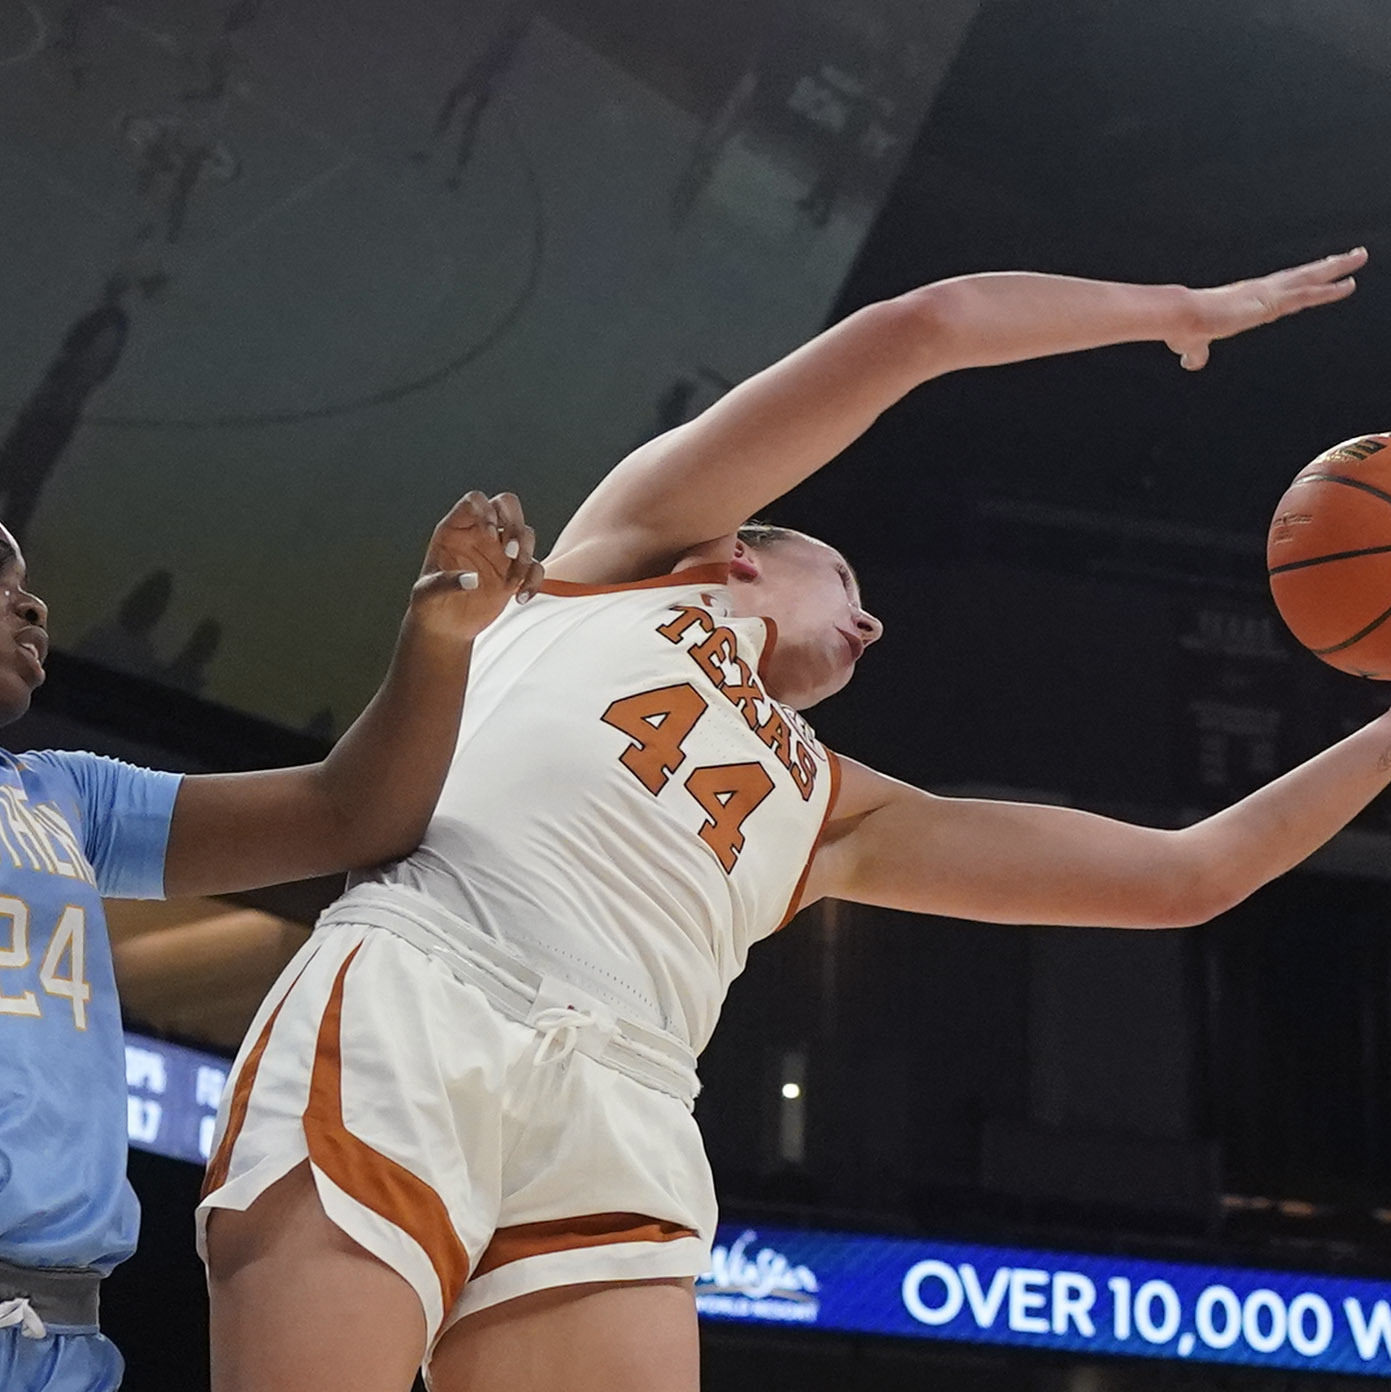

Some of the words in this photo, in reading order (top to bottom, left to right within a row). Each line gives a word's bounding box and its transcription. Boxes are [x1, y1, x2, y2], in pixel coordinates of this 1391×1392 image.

[600, 682, 776, 876] 44
[655, 605, 817, 802] TEXAS
[902, 1258, 1097, 1338] OVER
[1107, 1275, 1334, 1358] 10,000
